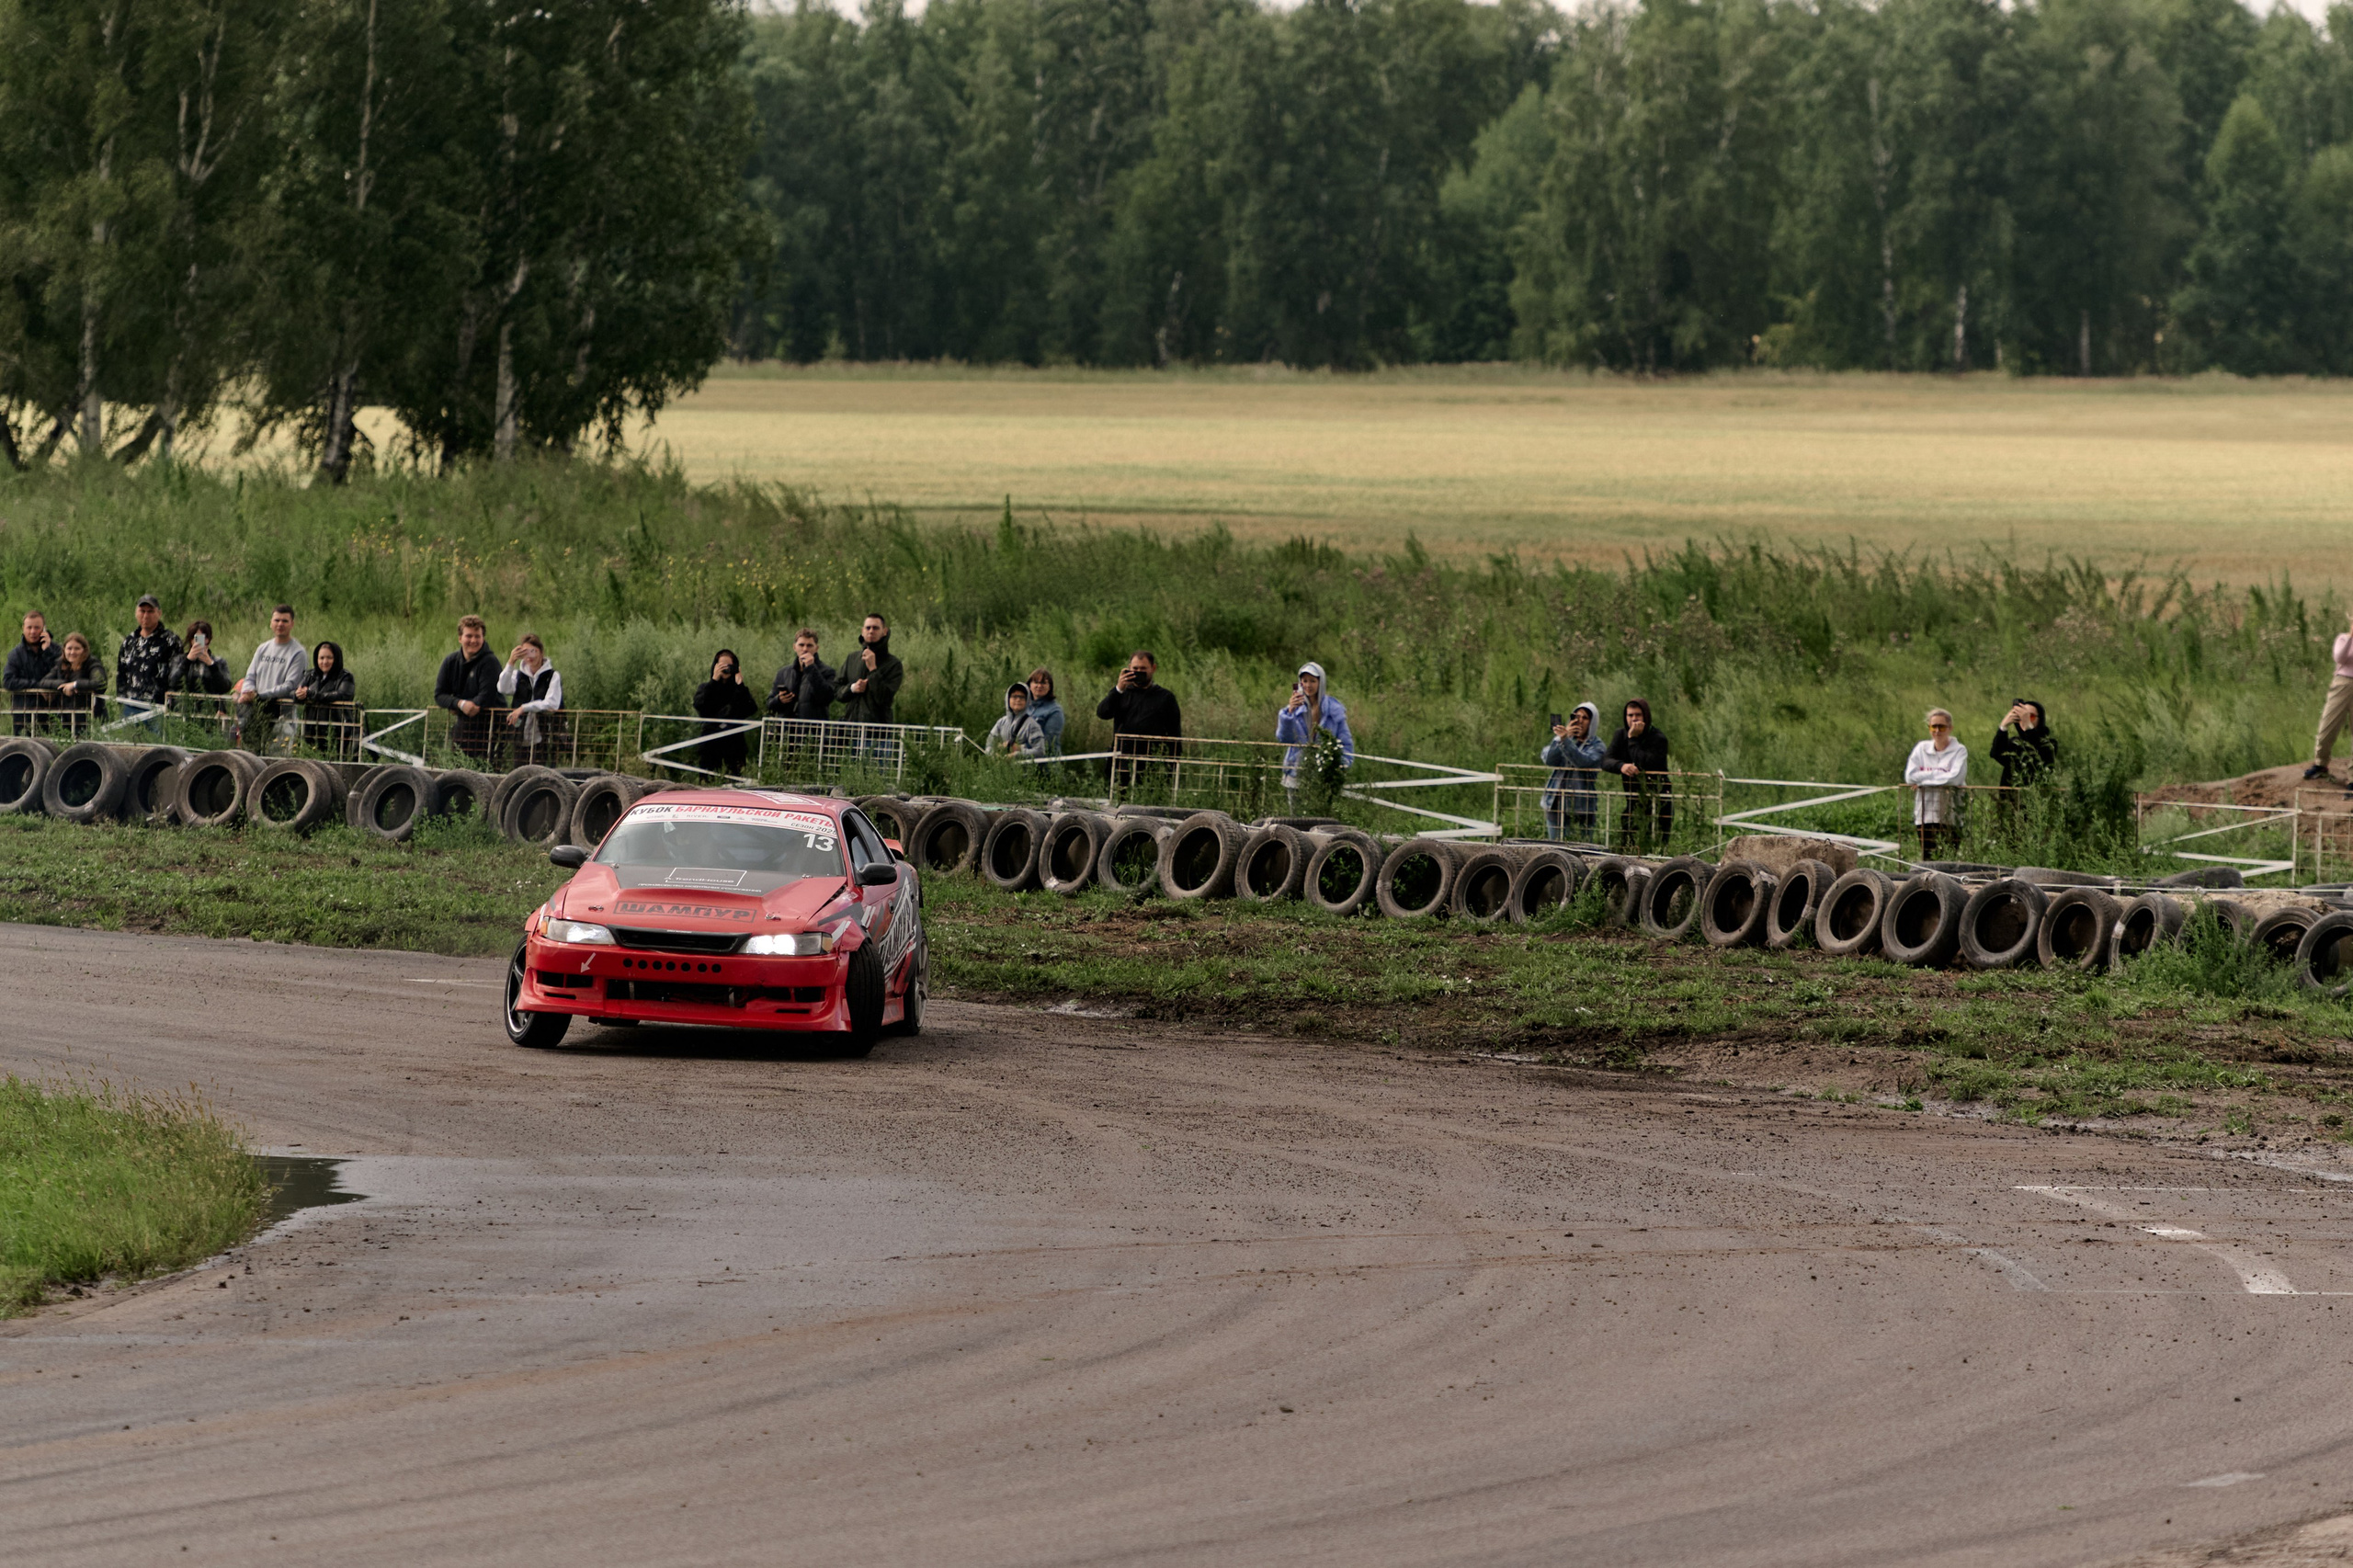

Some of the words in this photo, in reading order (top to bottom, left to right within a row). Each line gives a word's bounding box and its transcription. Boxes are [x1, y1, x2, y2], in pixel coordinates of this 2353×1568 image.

[631, 806, 673, 816] КУБОК
[676, 806, 781, 818] БАРНАУЛЬСКОЙ
[790, 822, 814, 830] СЕЗОН
[803, 833, 835, 852] 13
[620, 903, 750, 919] ШАМПУР
